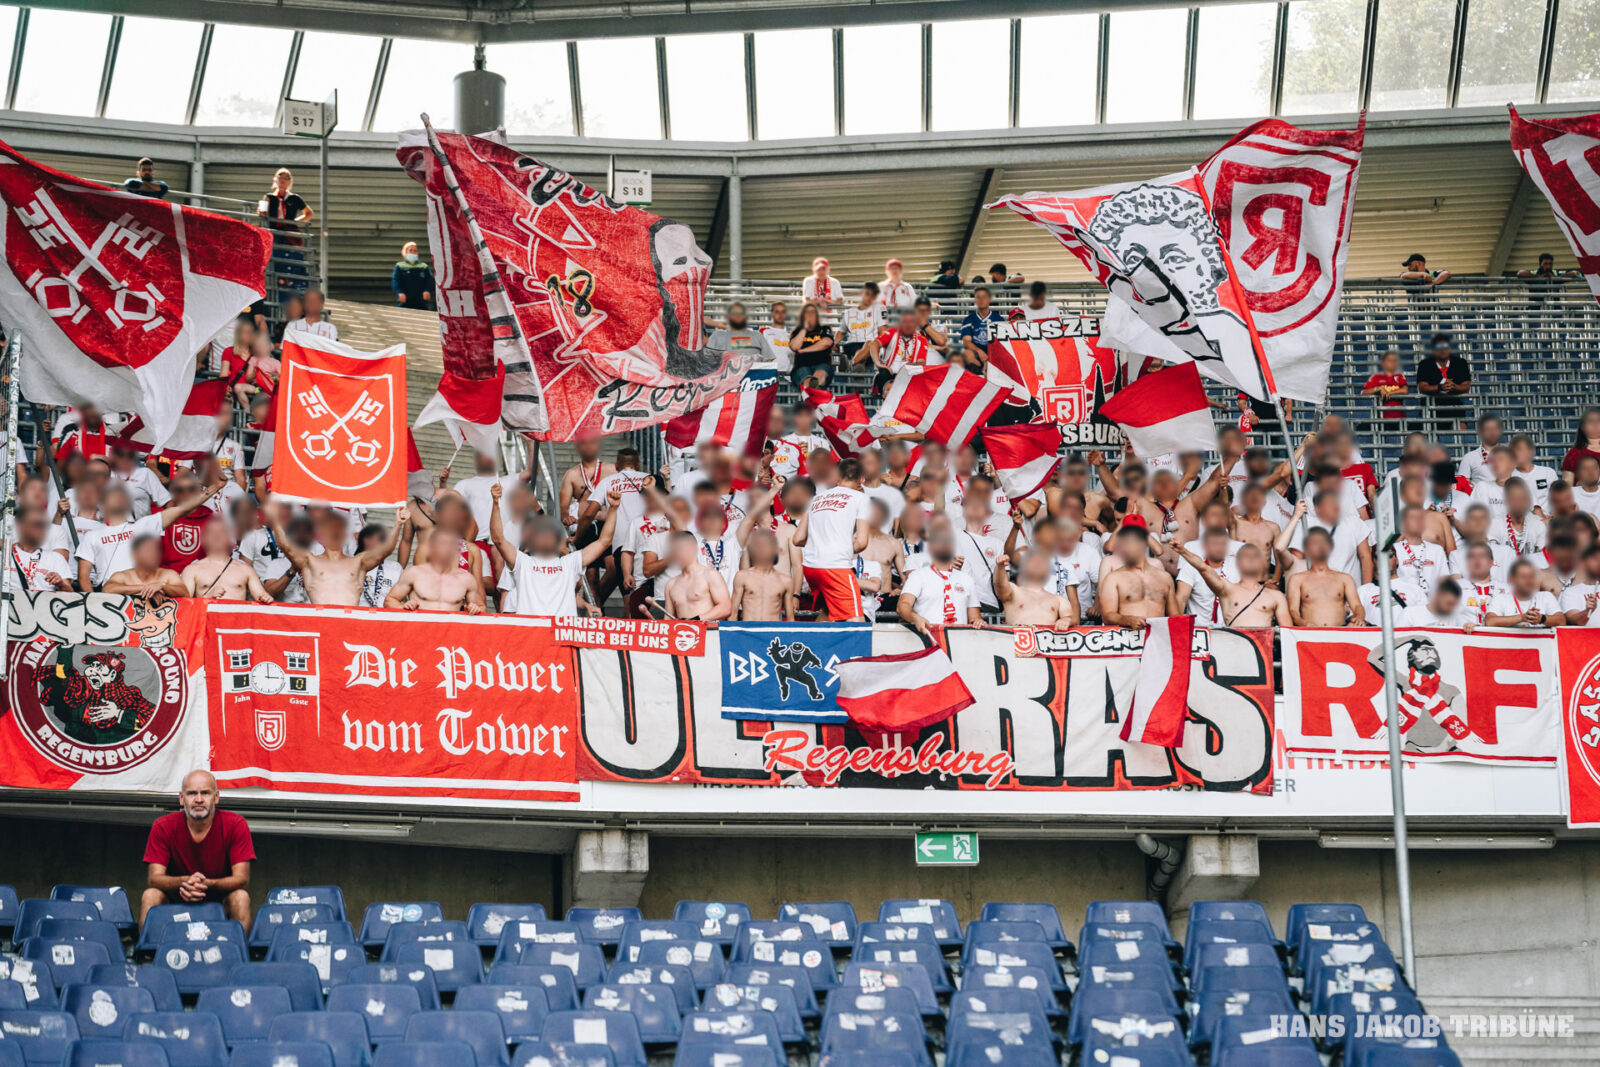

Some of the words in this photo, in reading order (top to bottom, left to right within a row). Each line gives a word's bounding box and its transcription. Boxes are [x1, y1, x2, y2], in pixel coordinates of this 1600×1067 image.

[292, 116, 300, 126] S
[303, 117, 314, 127] 17
[622, 186, 630, 196] S
[632, 187, 644, 197] 18
[987, 318, 1099, 341] FANSZE
[554, 615, 636, 633] CHRISTOPH
[640, 620, 670, 636] FÜR
[554, 628, 606, 646] IMMER
[609, 632, 635, 647] BEI
[638, 635, 670, 650] UNS
[1036, 631, 1085, 652] RED
[343, 640, 418, 689] Die
[435, 646, 566, 699] Power
[728, 651, 770, 686] BB
[36, 723, 159, 766] REGENSBURG
[341, 709, 425, 755] vom
[435, 707, 569, 759] Tower
[763, 729, 1016, 790] Regensburg
